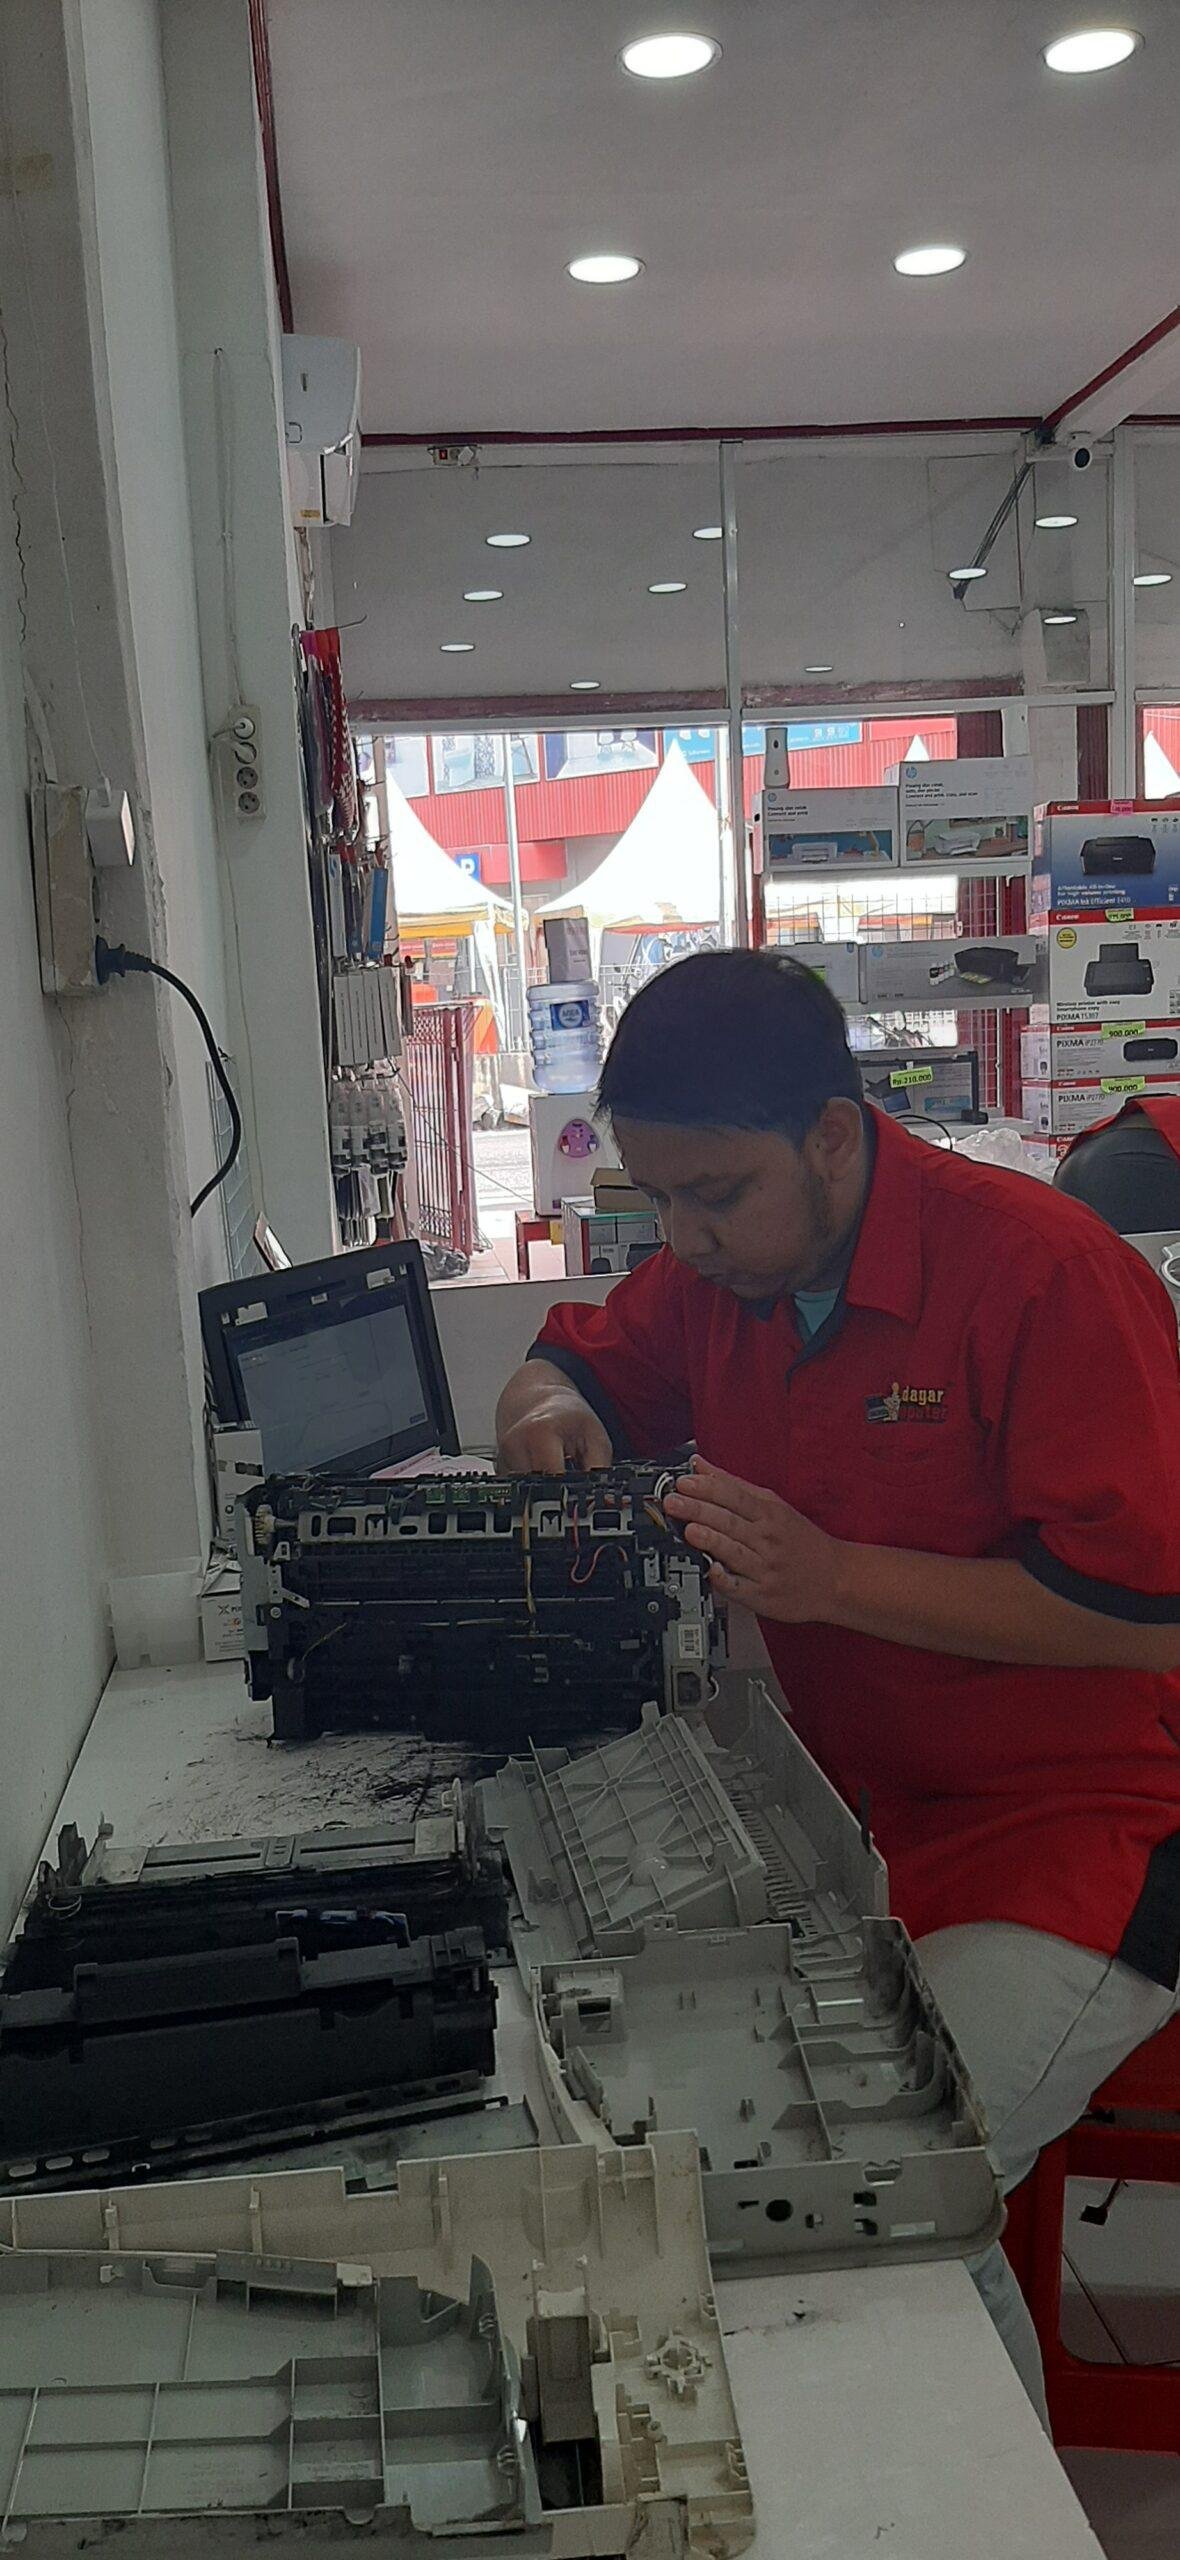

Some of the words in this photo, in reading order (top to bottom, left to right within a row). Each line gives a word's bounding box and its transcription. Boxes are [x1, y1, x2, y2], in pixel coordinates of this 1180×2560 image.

[1056, 1013, 1080, 1021] PIXMA
[1056, 1039, 1084, 1048] PIXMA
[1058, 1094, 1085, 1102] PIXMA
[902, 1385, 944, 1405] dagar
